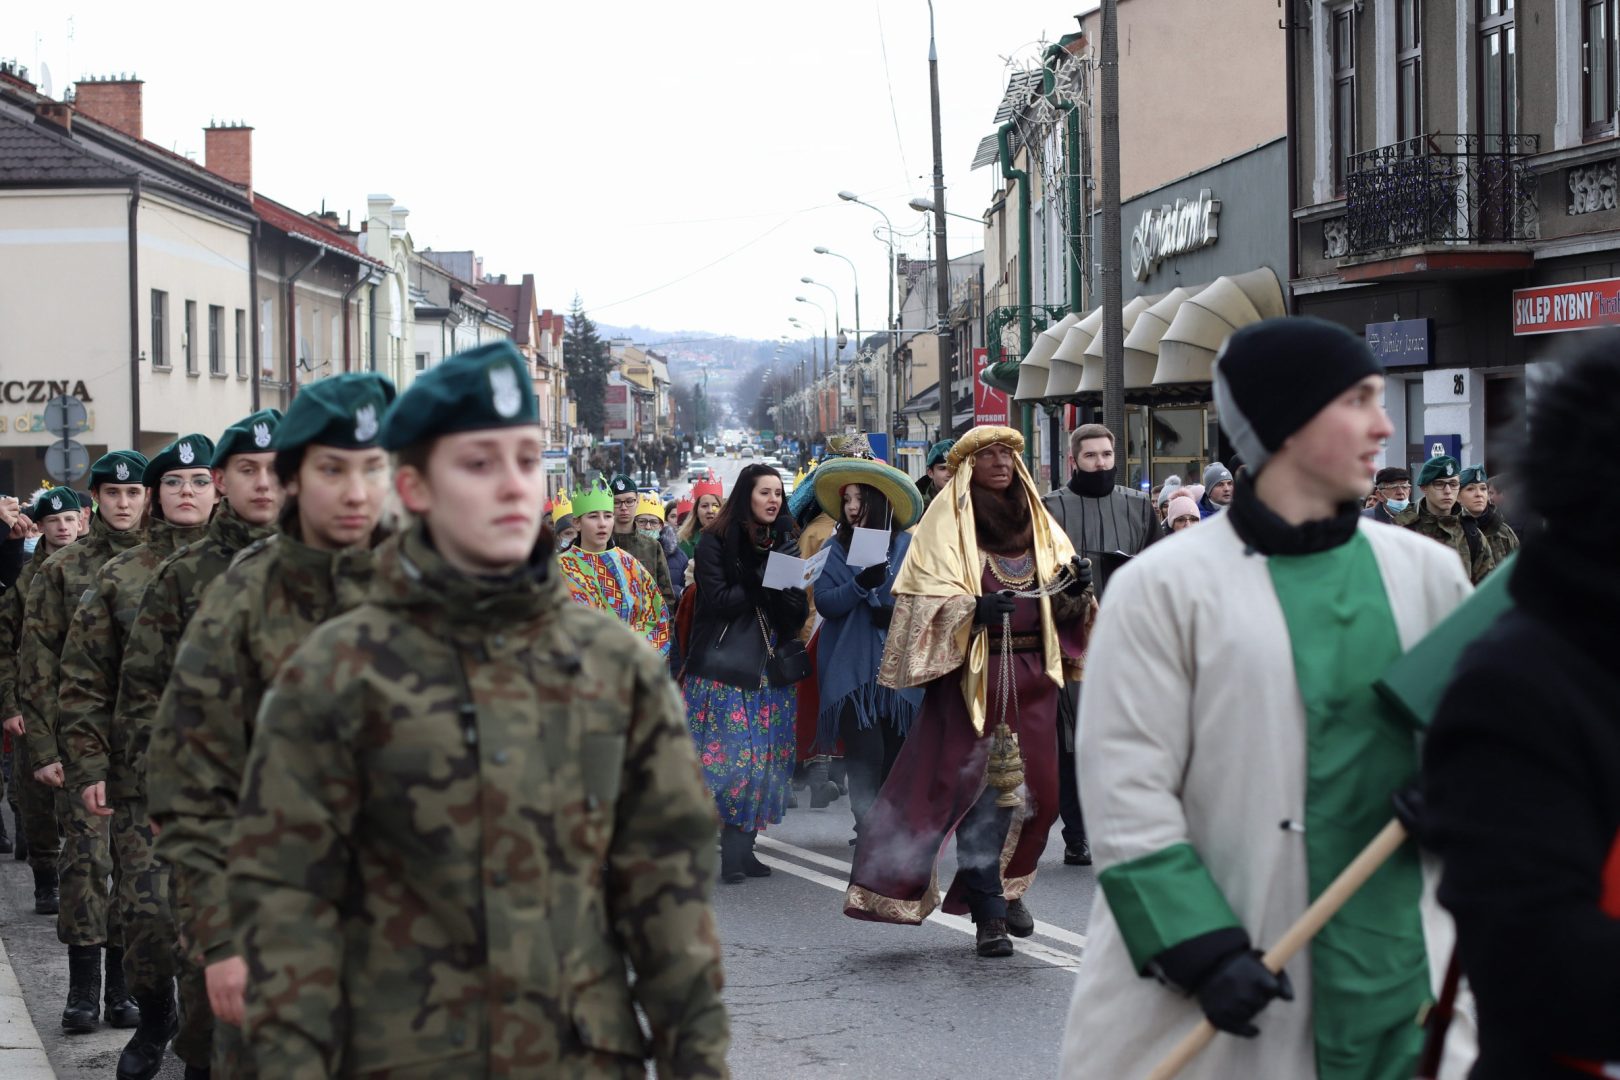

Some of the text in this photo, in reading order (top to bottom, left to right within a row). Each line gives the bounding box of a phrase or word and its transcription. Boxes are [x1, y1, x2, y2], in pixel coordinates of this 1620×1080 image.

[1516, 296, 1551, 326] SKLEP
[1553, 291, 1594, 322] RYBNY
[1453, 373, 1464, 395] 26
[976, 414, 1006, 422] DYSKONT
